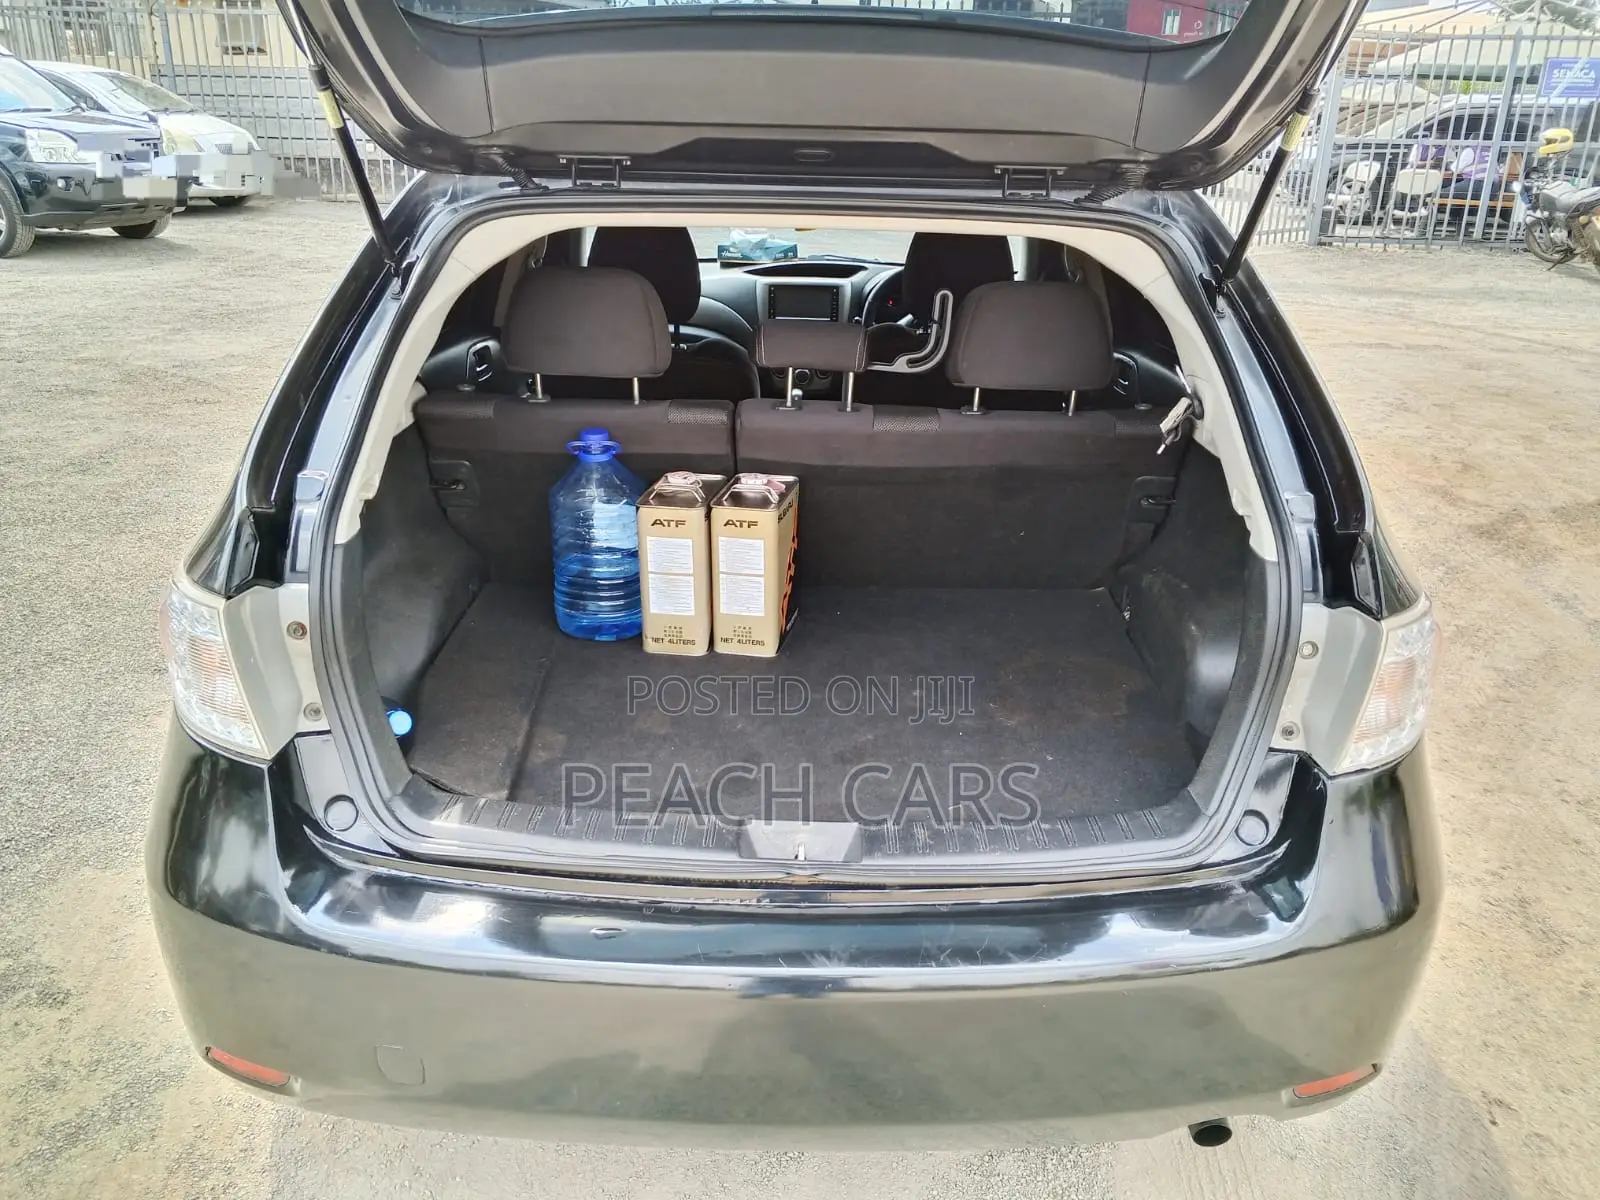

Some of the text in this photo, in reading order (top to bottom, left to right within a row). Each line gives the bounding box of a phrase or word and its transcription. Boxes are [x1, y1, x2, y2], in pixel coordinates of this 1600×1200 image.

[650, 518, 687, 528] ATF
[723, 518, 759, 528] ATF
[667, 637, 696, 646] 4LITERS
[720, 636, 765, 647] NET 4LITERS
